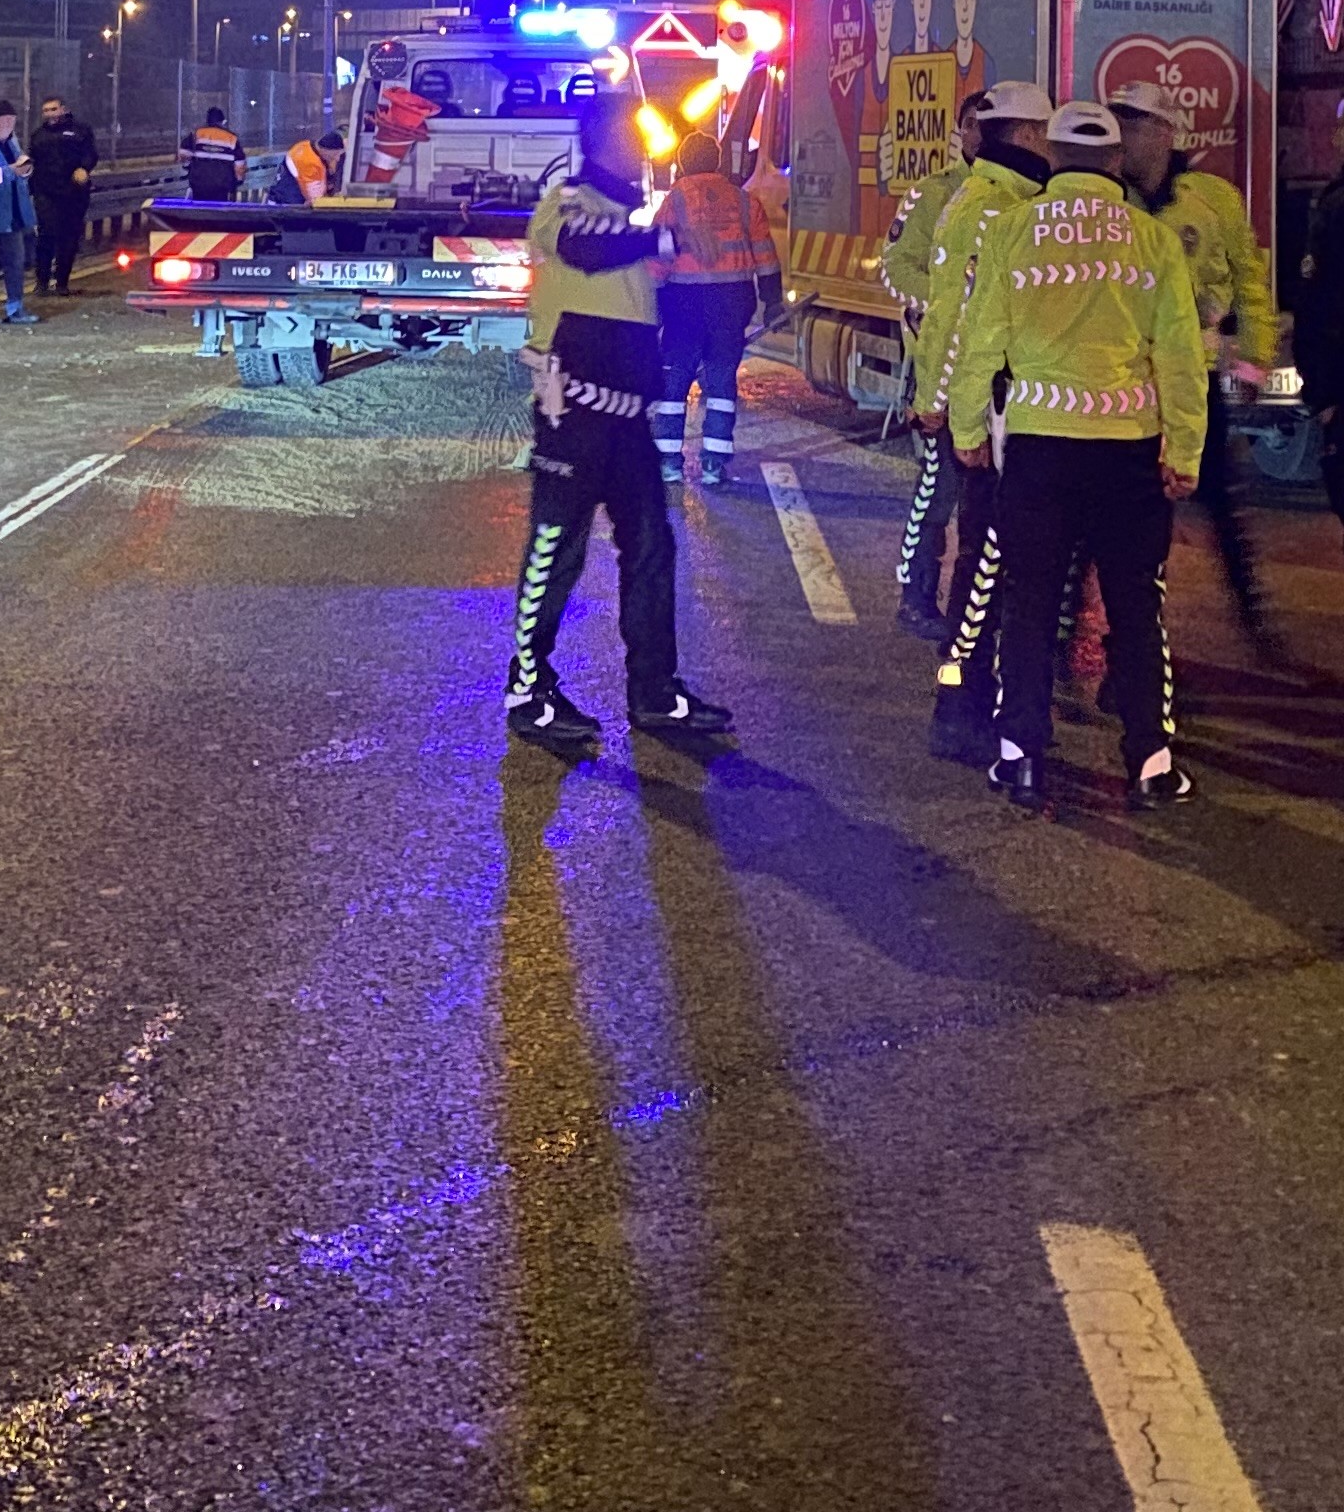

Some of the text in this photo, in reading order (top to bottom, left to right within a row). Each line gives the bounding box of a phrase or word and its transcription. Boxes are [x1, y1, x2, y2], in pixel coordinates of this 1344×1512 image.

[1134, 0, 1213, 14] BAŞKANLIĞI
[1155, 63, 1183, 85] 16
[906, 69, 936, 102] YOL
[896, 108, 946, 142] BAKIM
[1034, 198, 1130, 221] TRAFİK
[1034, 221, 1132, 247] POLİSİ
[232, 266, 272, 278] IVECO
[307, 262, 389, 280] 34 FKG 147
[421, 268, 462, 280] DAILY
